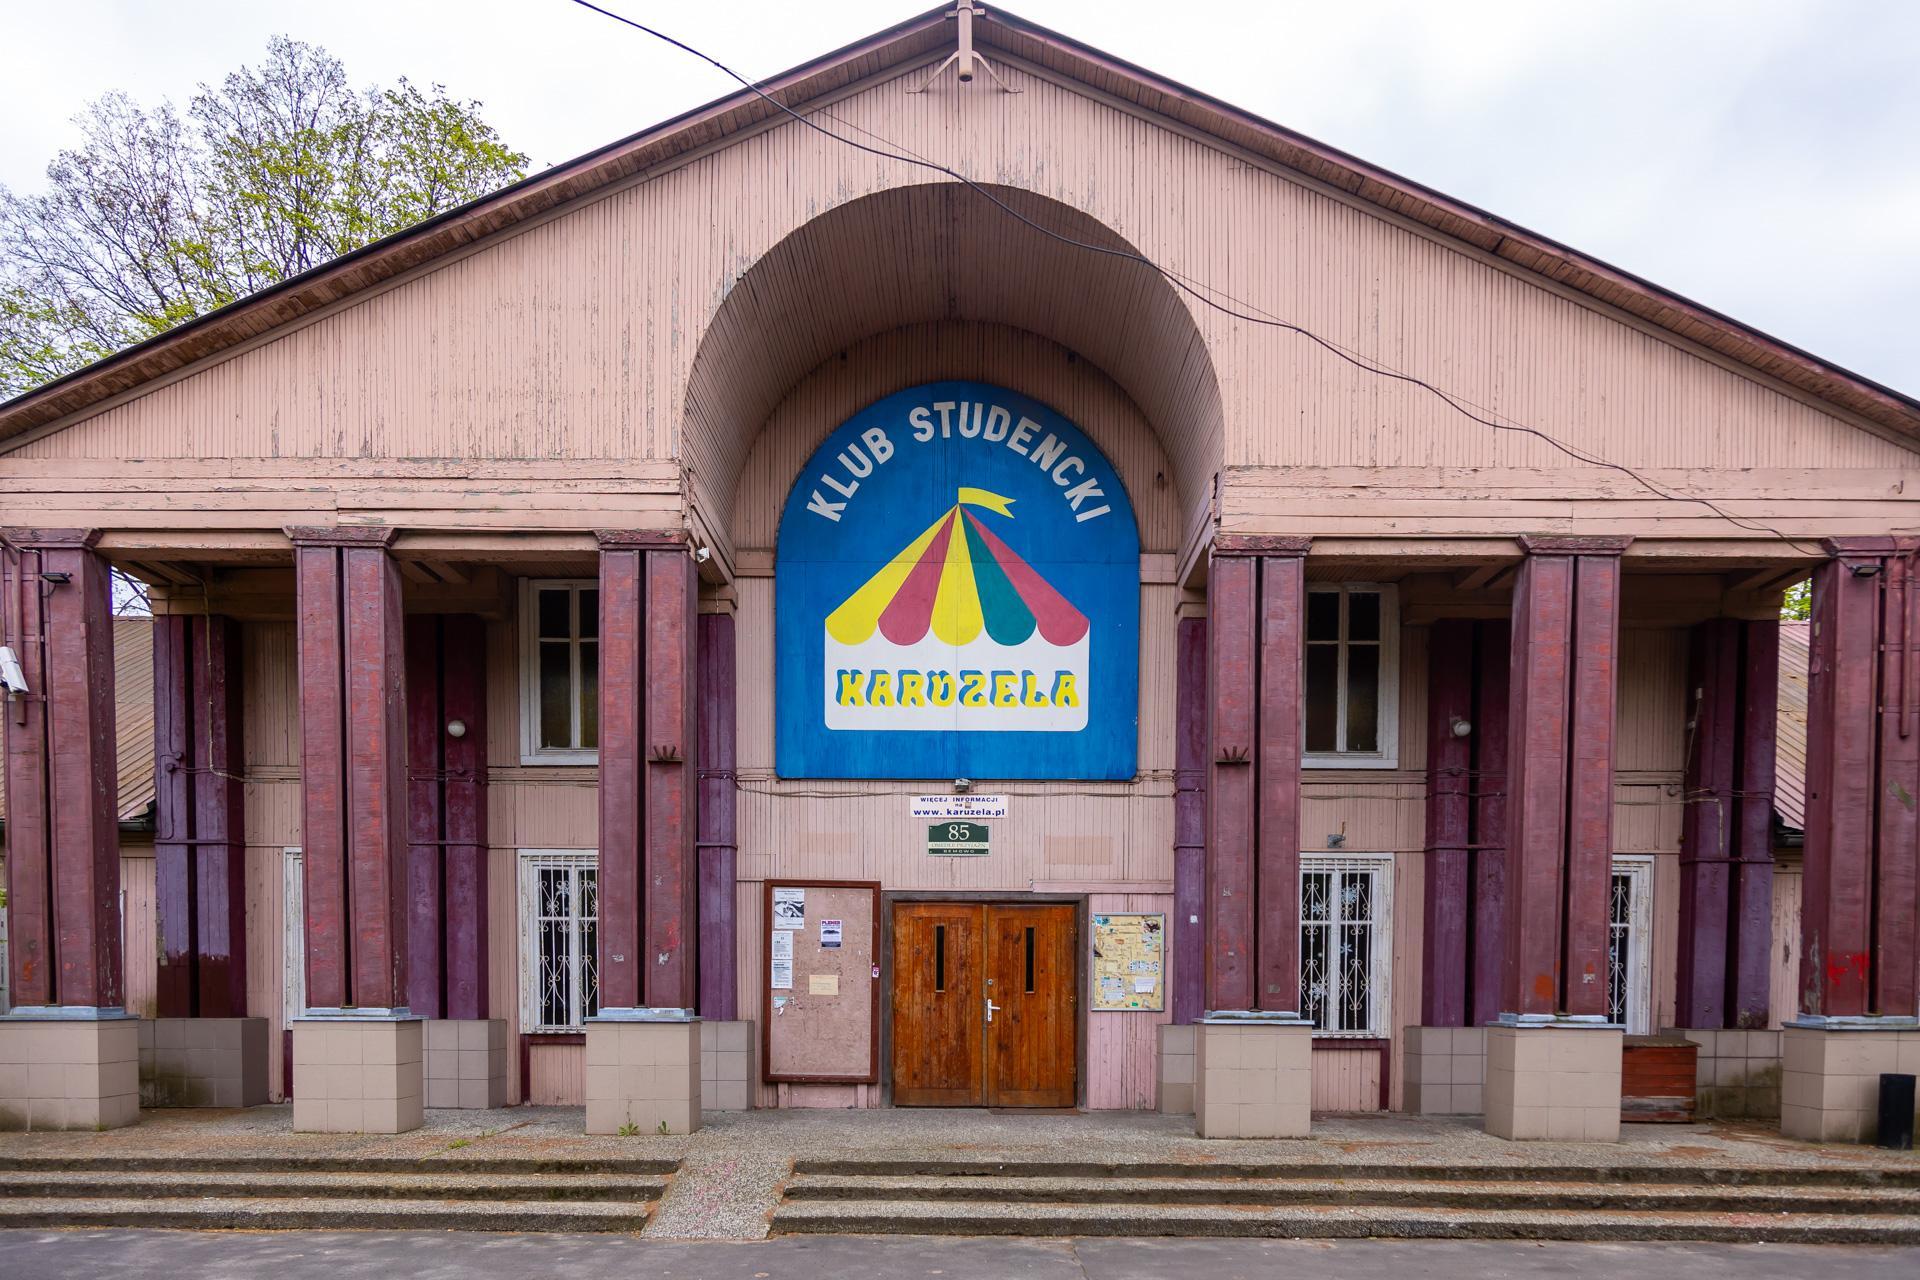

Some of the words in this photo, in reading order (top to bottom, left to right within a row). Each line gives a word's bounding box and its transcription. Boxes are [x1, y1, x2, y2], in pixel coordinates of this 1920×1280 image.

[806, 427, 895, 523] KLUB
[909, 401, 1111, 523] STUDENCKI
[835, 669, 1080, 708] KARUZELA
[948, 824, 969, 840] 85
